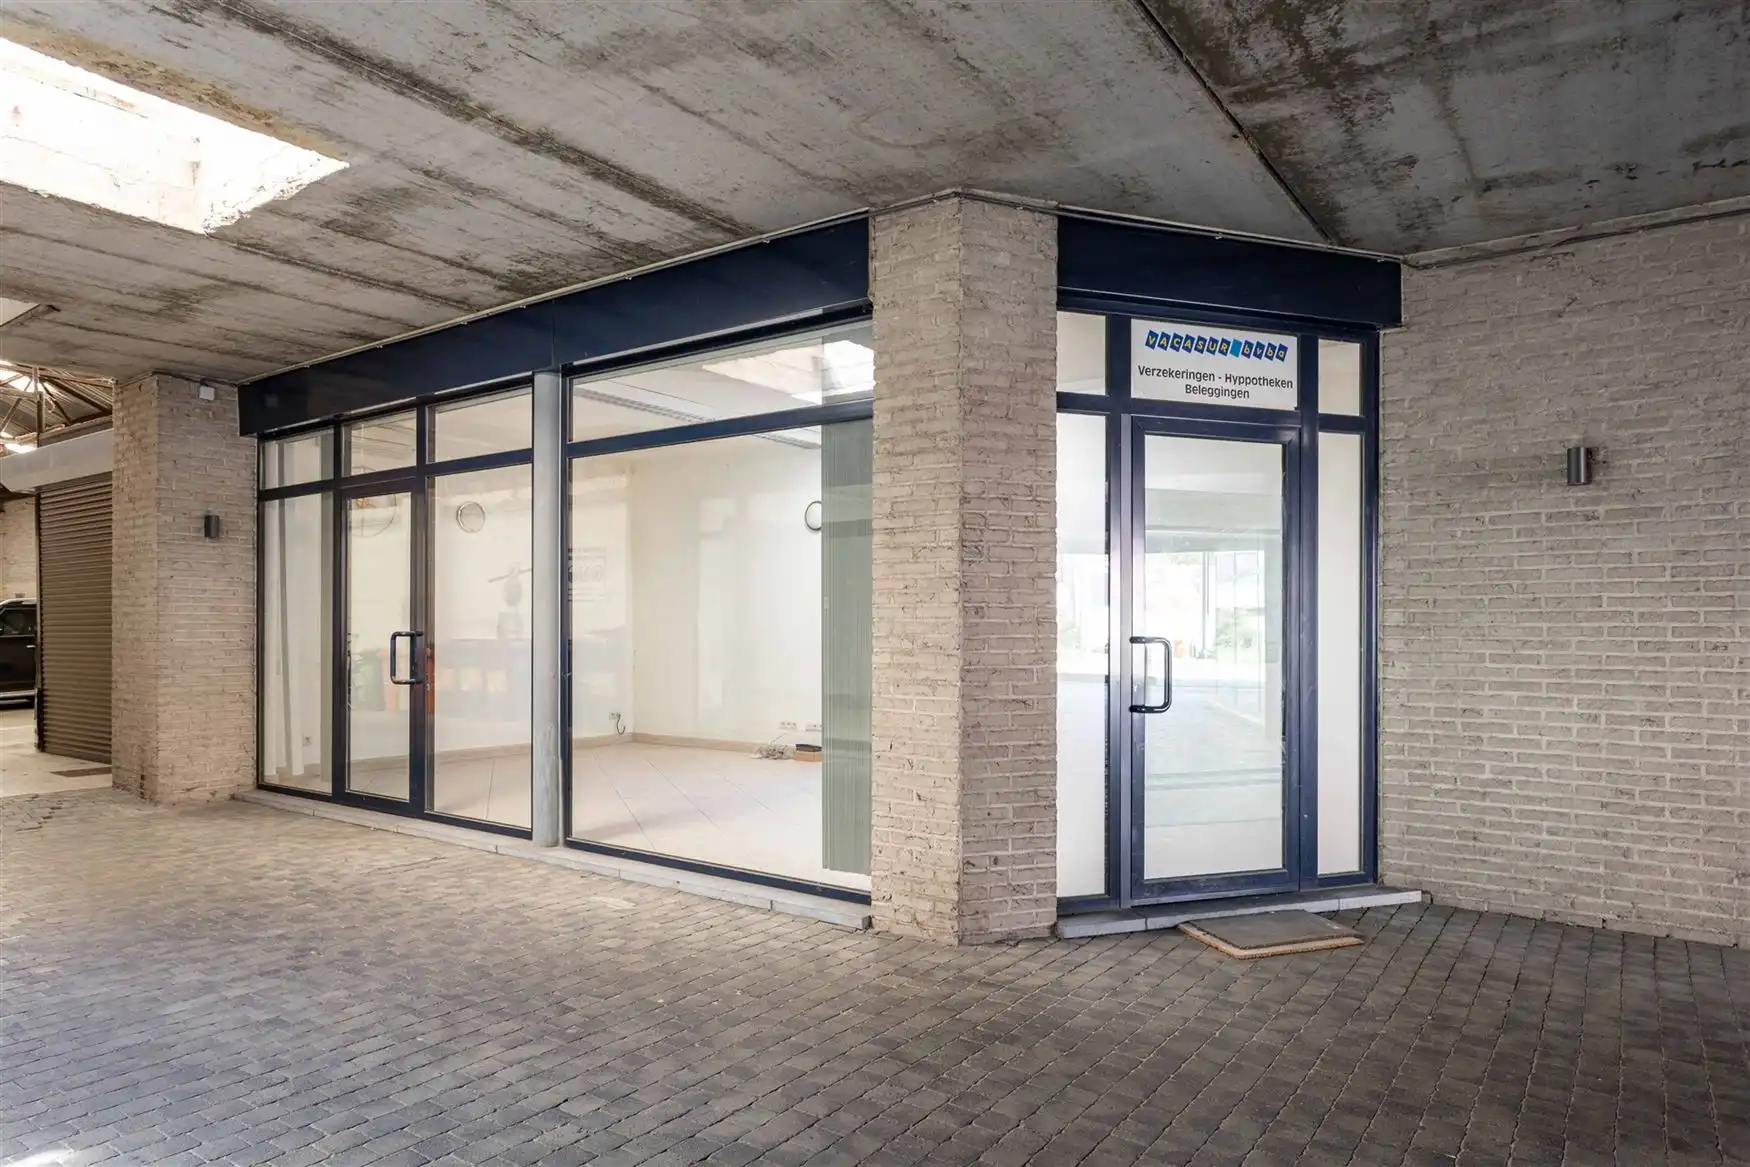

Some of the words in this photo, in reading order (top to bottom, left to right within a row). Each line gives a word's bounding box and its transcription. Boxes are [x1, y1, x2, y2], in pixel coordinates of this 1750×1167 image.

[1147, 335, 1228, 353] VACASUR
[1138, 365, 1215, 382] Verzekeringen
[1225, 373, 1293, 389] Hyppotheken
[1185, 384, 1250, 399] Beleggingen
